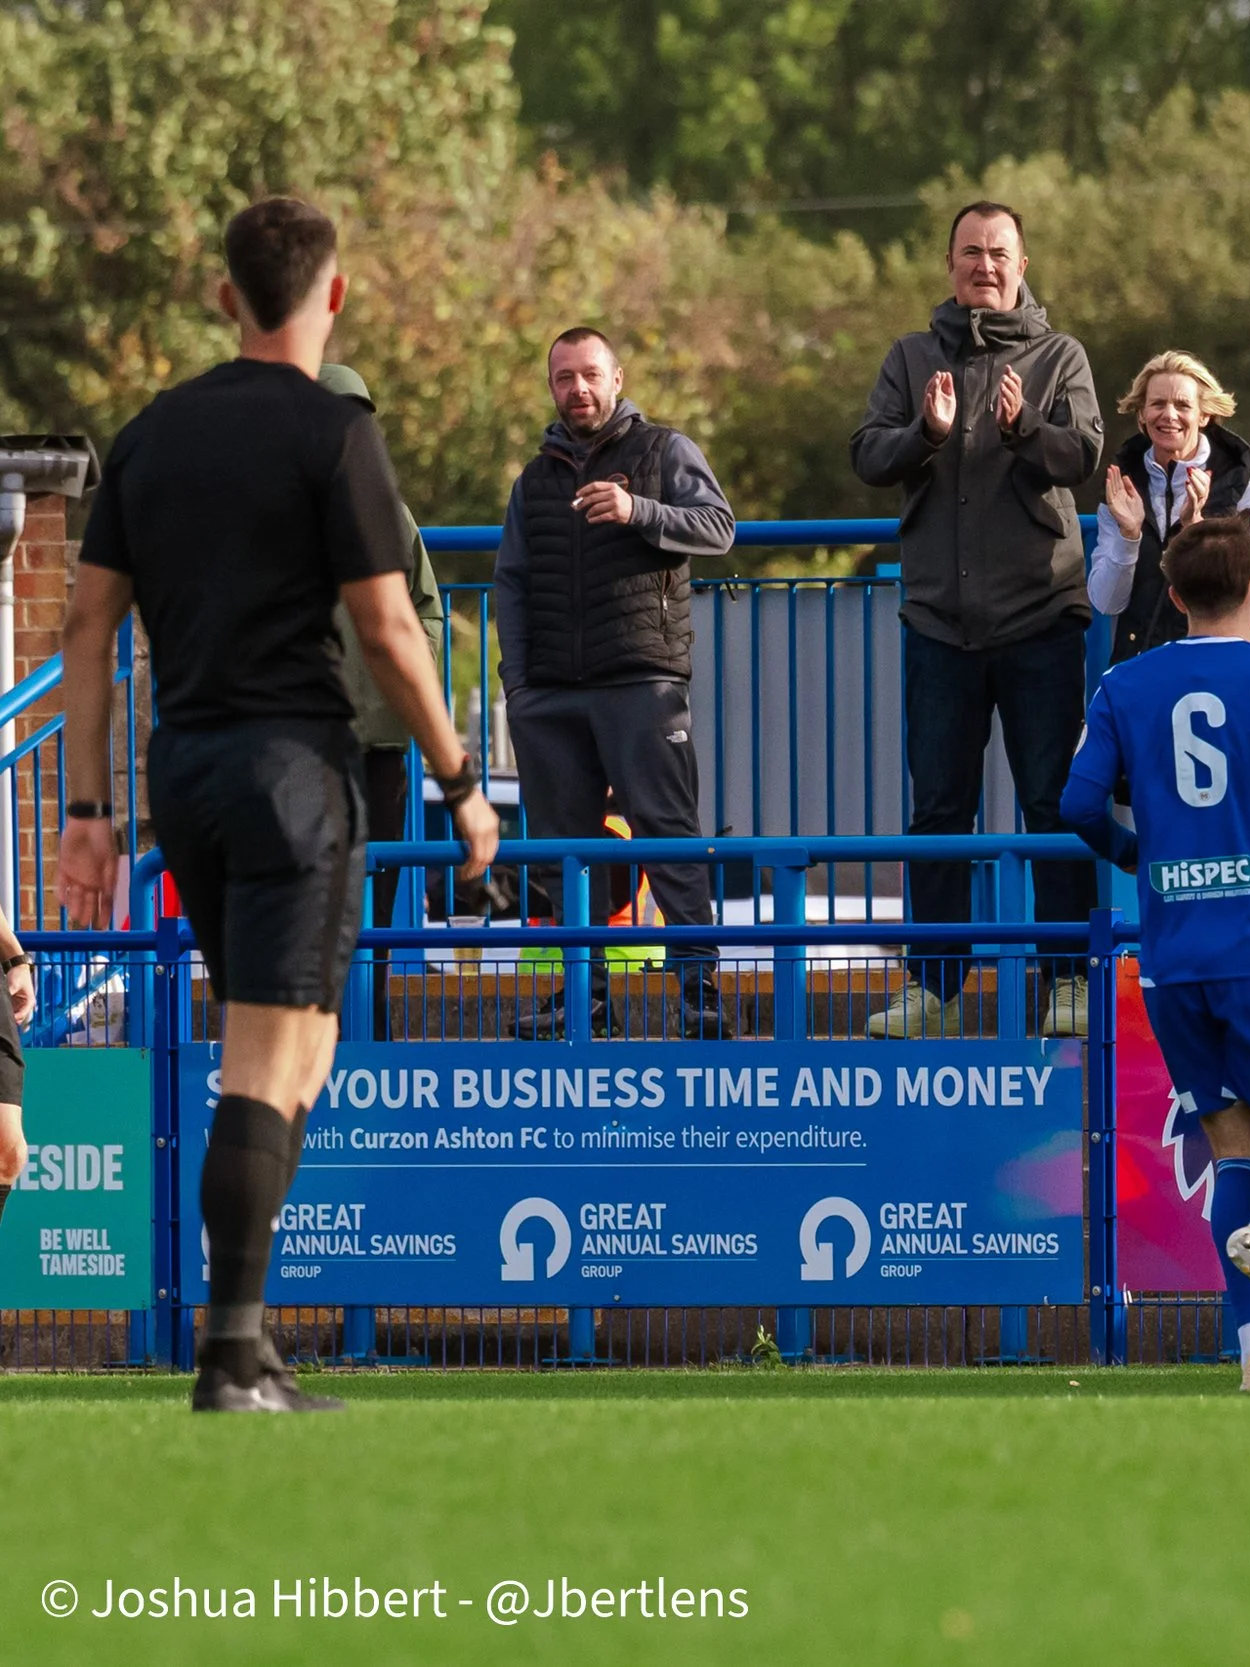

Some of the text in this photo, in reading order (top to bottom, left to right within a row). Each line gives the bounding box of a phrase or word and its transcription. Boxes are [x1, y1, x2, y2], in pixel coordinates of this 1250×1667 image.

[1171, 691, 1228, 807] 6
[325, 1066, 1054, 1109] YOUR BUSINESS TIME AND MONEY
[301, 1124, 867, 1154] with Curzon Ashton FC to minimise their expenditure.
[11, 1144, 124, 1191] ESIDE
[281, 1204, 367, 1231] GREAT
[580, 1203, 666, 1230] GREAT
[879, 1203, 965, 1230] GREAT
[40, 1229, 112, 1250] BE WELL
[281, 1234, 458, 1256] ANNUAL SAVINGS
[580, 1233, 759, 1255] ANNUAL SAVINGS
[879, 1233, 1058, 1255] ANNUAL SAVINGS
[39, 1254, 125, 1276] TAMESIDE
[281, 1265, 323, 1279] GROUP
[580, 1264, 623, 1278] GROUP
[879, 1264, 922, 1278] GROUP
